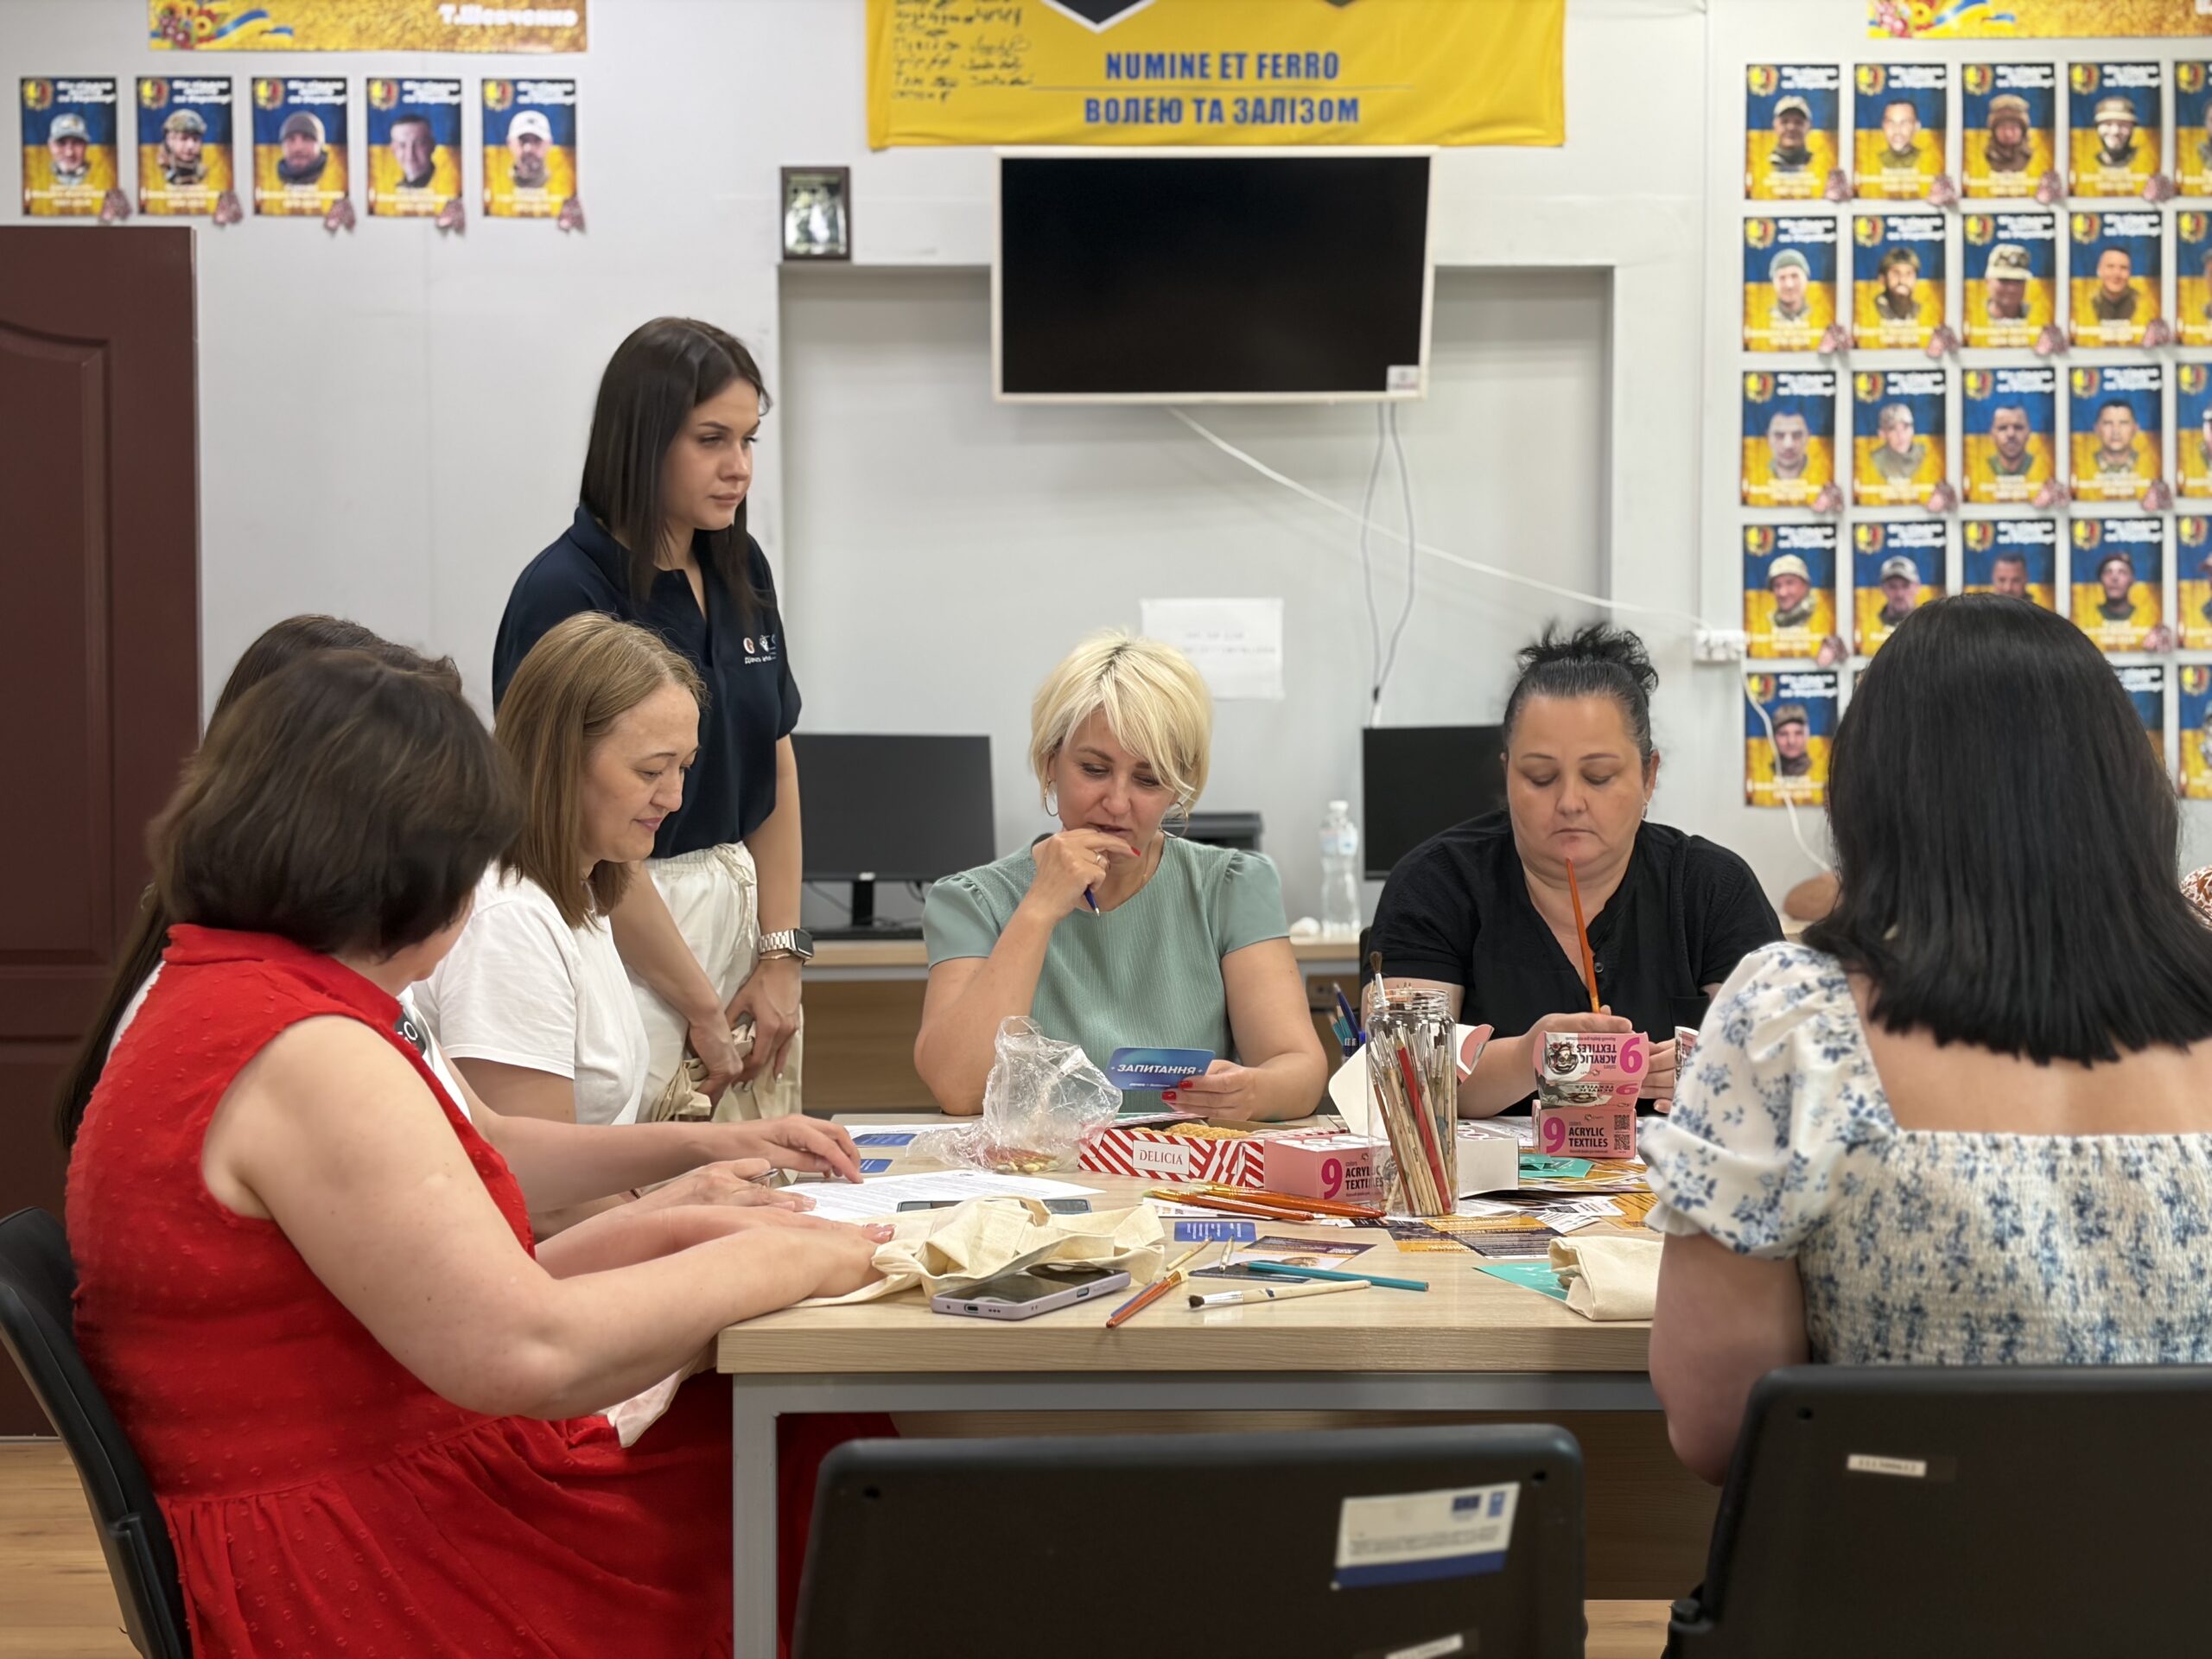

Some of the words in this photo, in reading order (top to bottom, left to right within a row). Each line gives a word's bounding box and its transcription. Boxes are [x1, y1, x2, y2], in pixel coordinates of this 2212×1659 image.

[1105, 52, 1211, 80] NUMINE
[1219, 52, 1249, 80] ET
[1256, 51, 1340, 80] FERRO
[1084, 97, 1184, 124] ВОЛЕЮ
[1192, 98, 1224, 124] ТА
[1233, 97, 1359, 124] ЗАЛІЗОМ
[1576, 1044, 1617, 1053] TEXTILES
[1580, 1055, 1617, 1064] ACRYLIC
[1117, 1064, 1197, 1075] ЗАПИТАННЯ
[1543, 1117, 1566, 1154] 9
[1568, 1127, 1605, 1137] ACRYLIC
[1568, 1138, 1608, 1147] TEXTILES
[1140, 1149, 1183, 1165] DELICIA
[1321, 1158, 1343, 1199] 9
